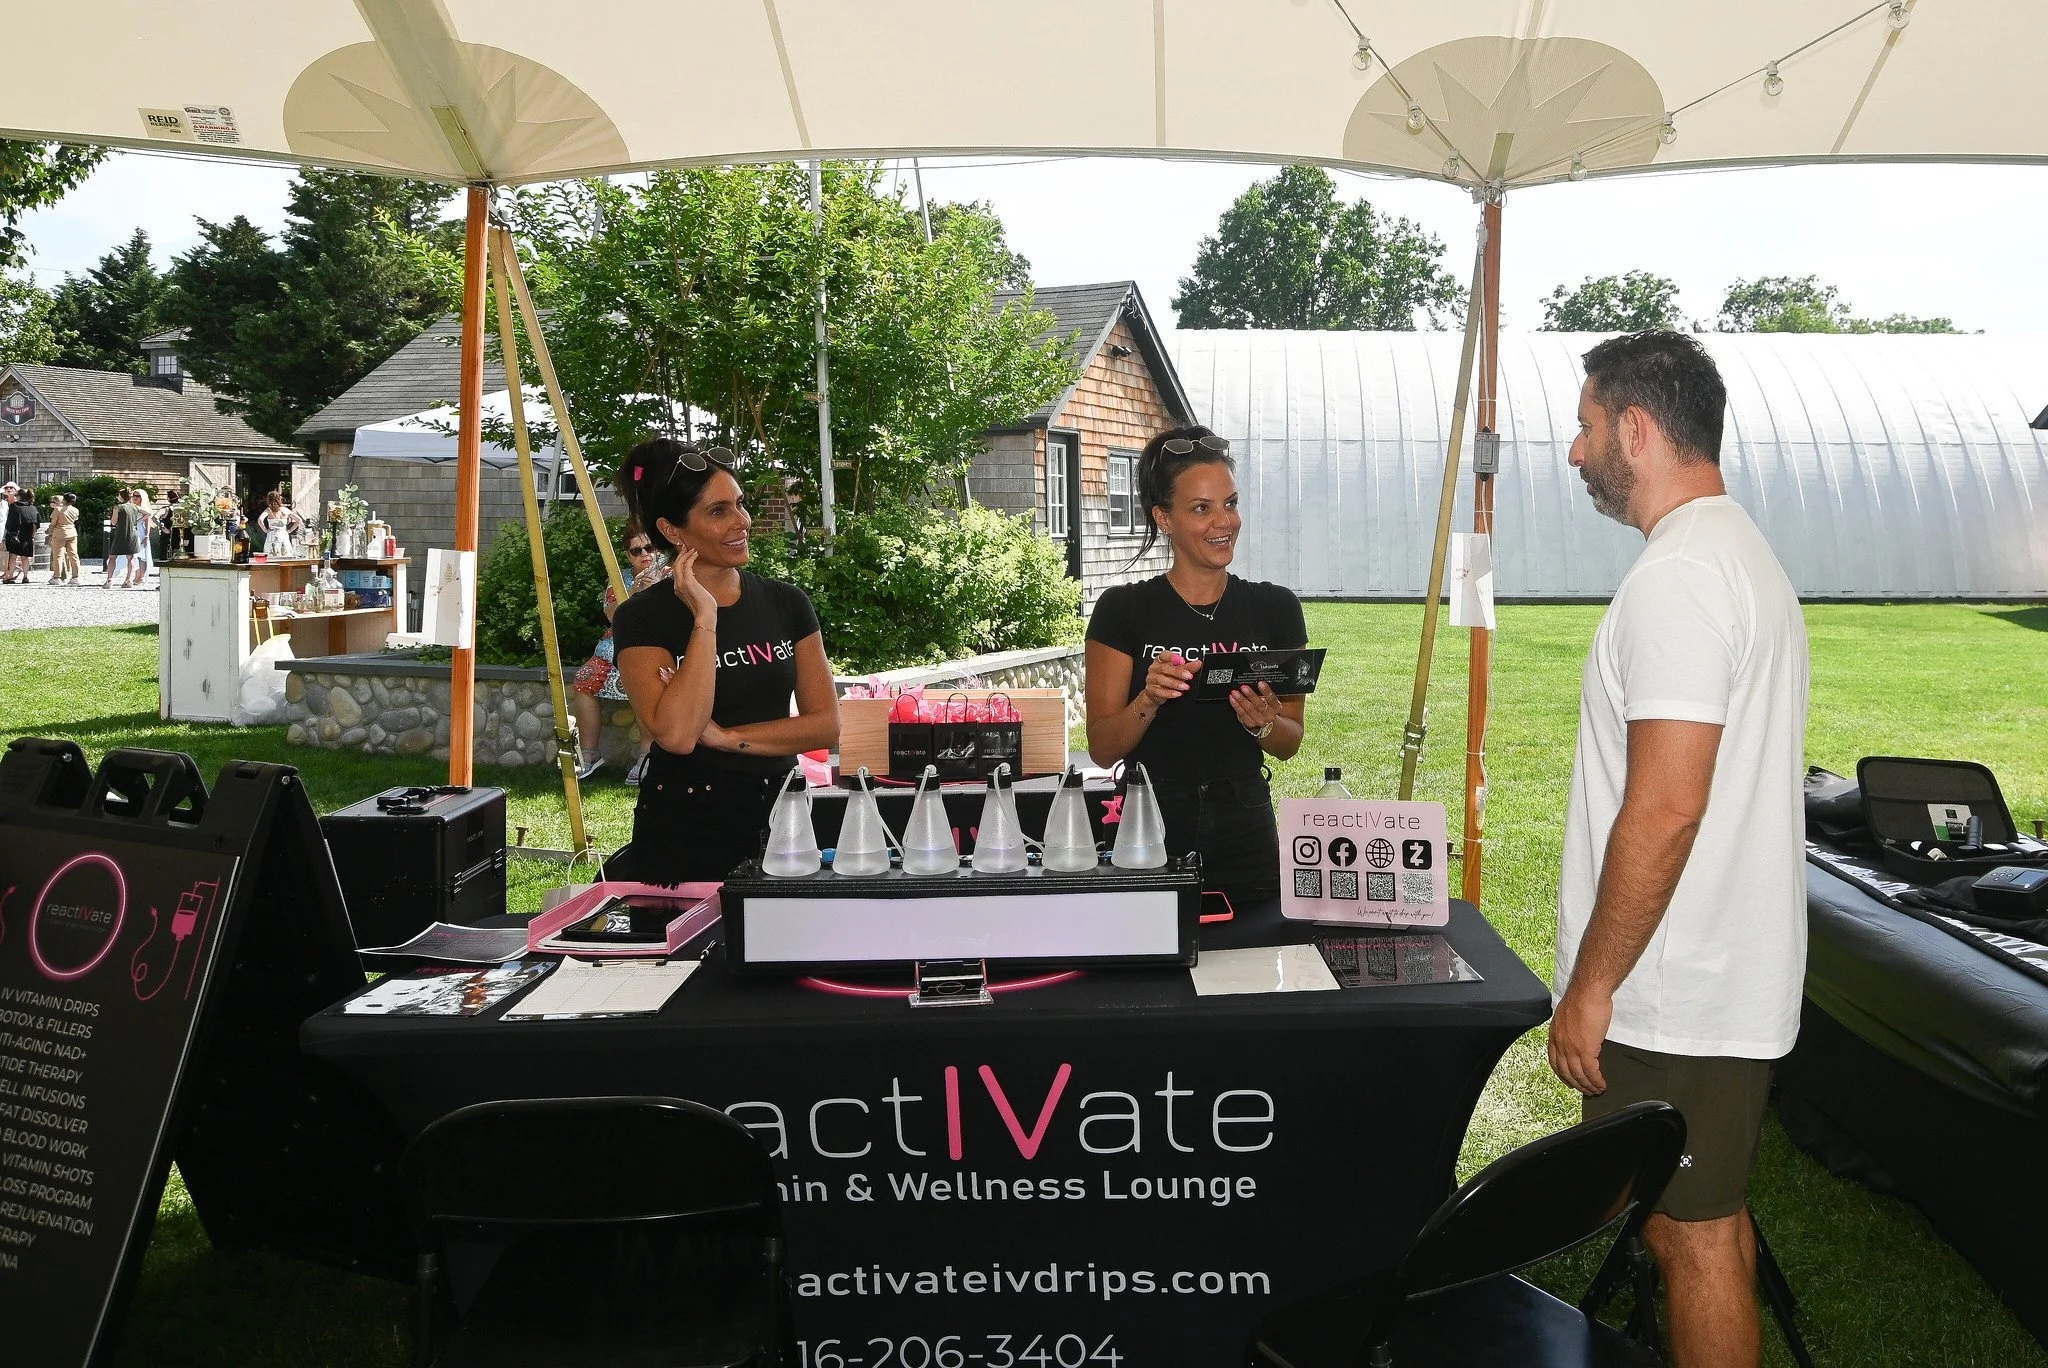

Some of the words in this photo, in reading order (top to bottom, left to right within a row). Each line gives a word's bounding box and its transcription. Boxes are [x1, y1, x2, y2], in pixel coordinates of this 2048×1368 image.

[148, 114, 179, 124] RFID
[676, 639, 794, 671] rctIVate
[1302, 811, 1421, 830] reactIVate
[46, 903, 112, 924] reactIVate
[1, 988, 14, 1000] IV
[16, 990, 62, 1009] VITAMIN
[64, 999, 101, 1017] DRIPS
[36, 1017, 45, 1029] &
[46, 1018, 93, 1039] FILLERS
[54, 1043, 87, 1060] NAD+
[29, 1060, 83, 1083] THERAPY
[21, 1084, 87, 1109] INFUSIONS
[21, 1107, 89, 1135] DISSOLVER
[3, 1128, 47, 1149] BLOOD
[50, 1138, 89, 1159] WORK
[3, 1152, 52, 1176] VITAMIN
[53, 1163, 95, 1185] SHOTS
[28, 1183, 93, 1210] PROGRAM
[846, 1173, 875, 1202] &
[887, 1171, 1086, 1202] Wellness
[1103, 1170, 1257, 1207] Lounge
[0, 1201, 95, 1236] REJUVENATION
[797, 1262, 1272, 1301] activateivdrips.com
[796, 1333, 1124, 1368] 16-206-3404
